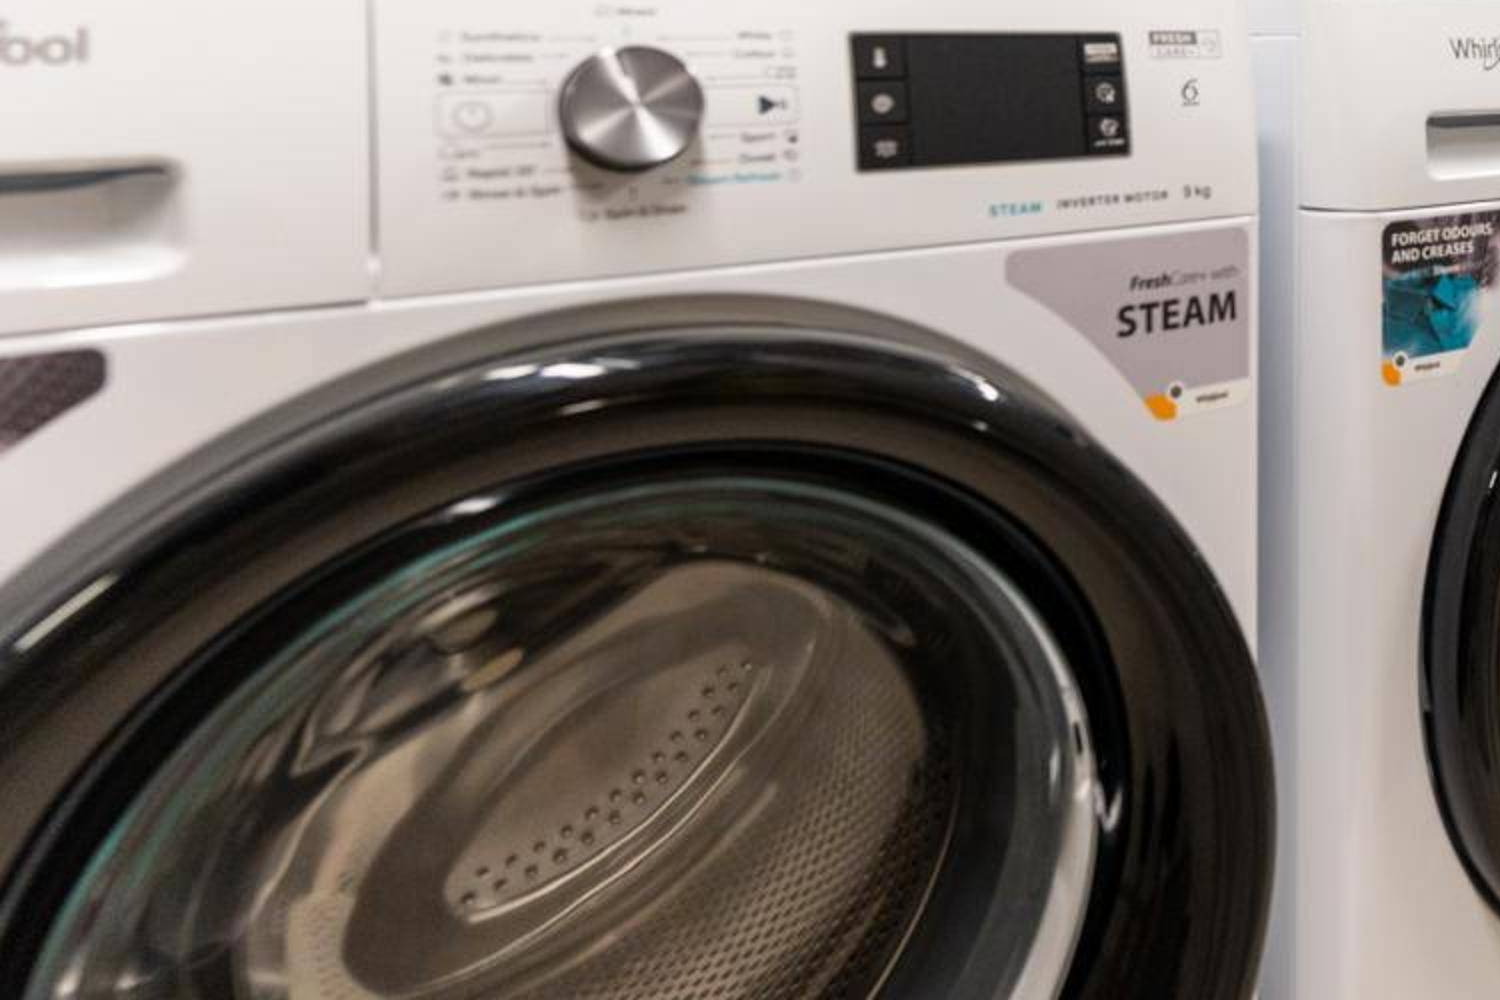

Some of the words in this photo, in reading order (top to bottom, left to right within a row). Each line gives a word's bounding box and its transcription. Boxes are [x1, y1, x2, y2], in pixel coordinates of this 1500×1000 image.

[989, 203, 1043, 218] STEAM
[1055, 194, 1121, 211] INVERTER
[1123, 189, 1169, 204] MOTOR
[1391, 229, 1439, 247] FORGET
[1442, 224, 1493, 242] ODOURS
[1391, 247, 1420, 264] AND
[1422, 241, 1475, 261] CREASES
[1117, 290, 1237, 338] STEAM
